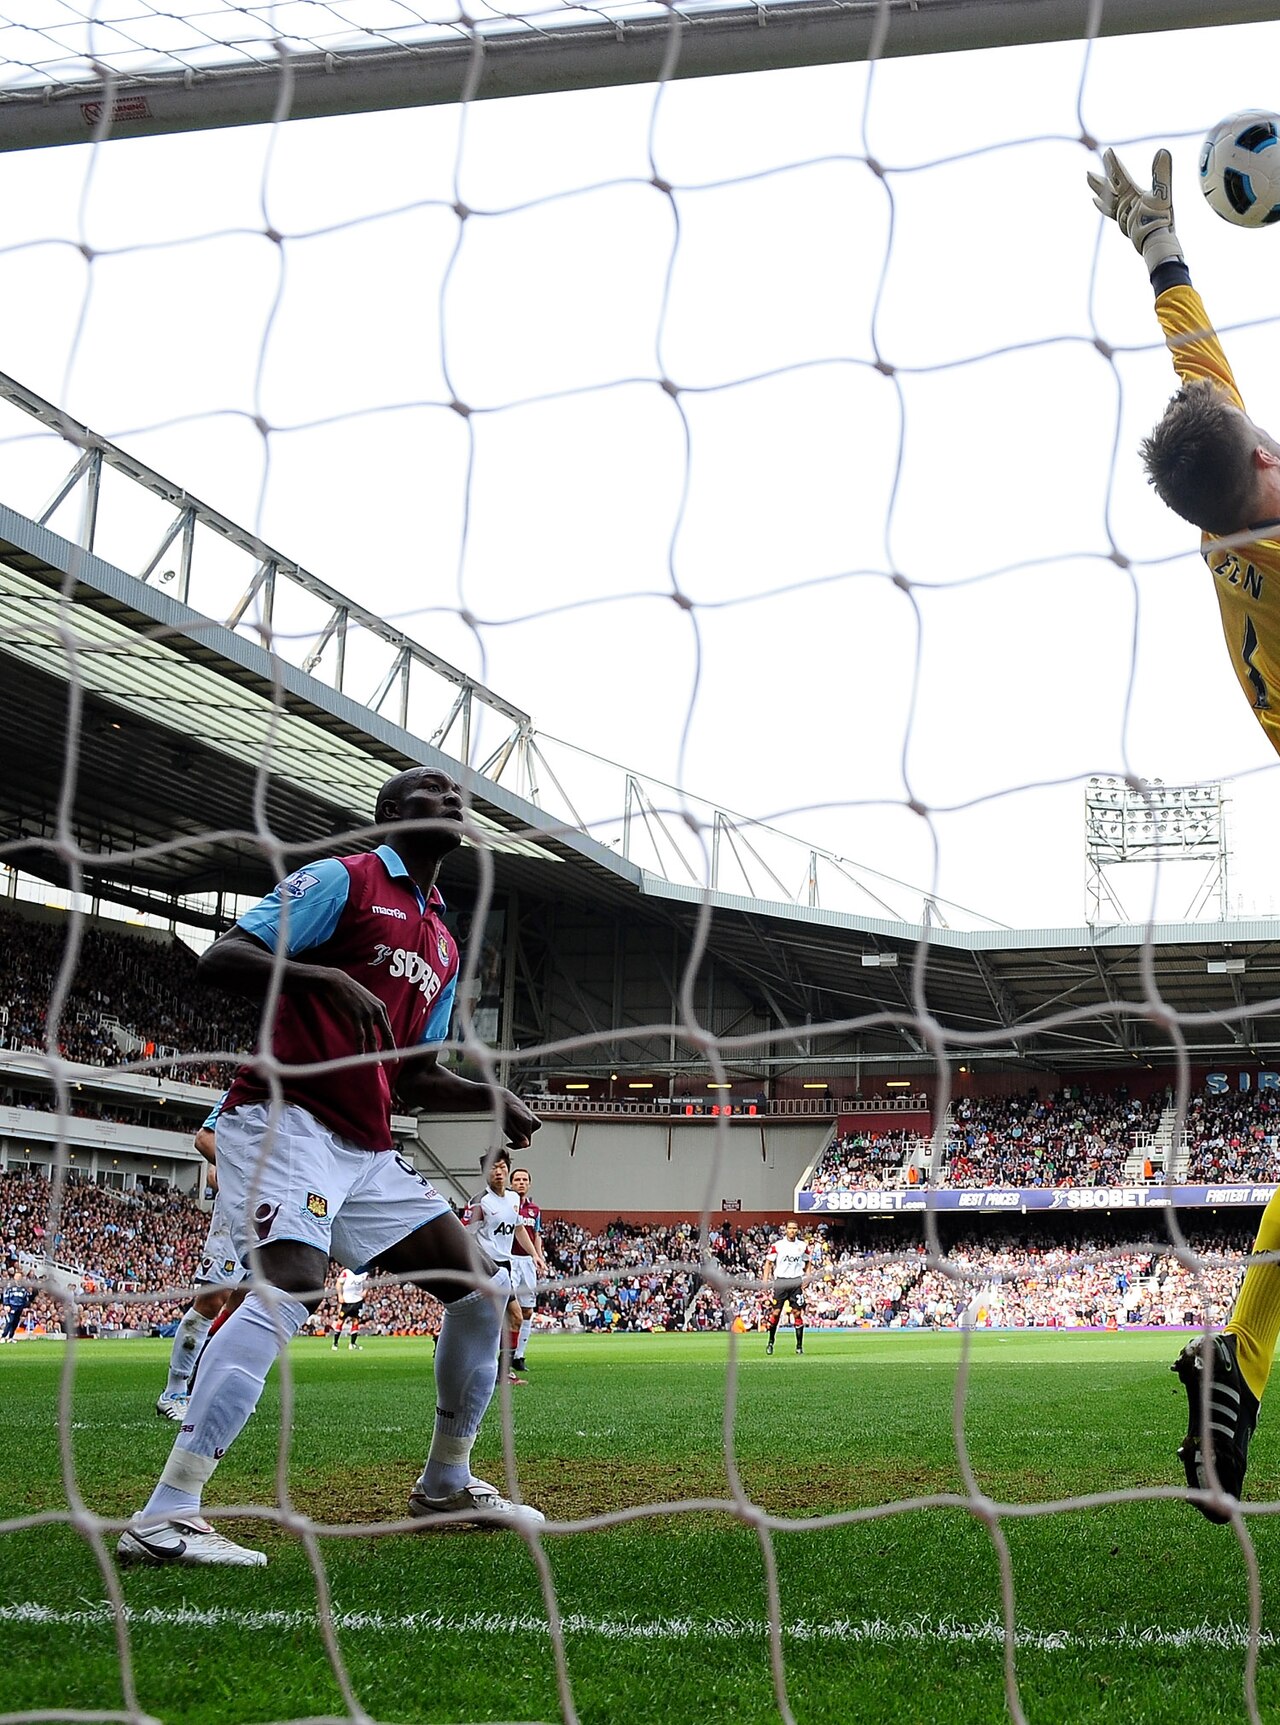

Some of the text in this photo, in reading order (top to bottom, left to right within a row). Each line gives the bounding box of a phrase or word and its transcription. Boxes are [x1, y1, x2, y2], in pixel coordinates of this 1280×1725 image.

[111, 102, 146, 113] ARNING
[372, 905, 407, 920] macron
[389, 947, 441, 1006] SBOBE
[827, 1192, 926, 1210] SBOBET.com
[959, 1192, 1021, 1206] BEST PRICES
[1067, 1188, 1171, 1208] SBOBET.com
[1205, 1189, 1251, 1203] FASTEST
